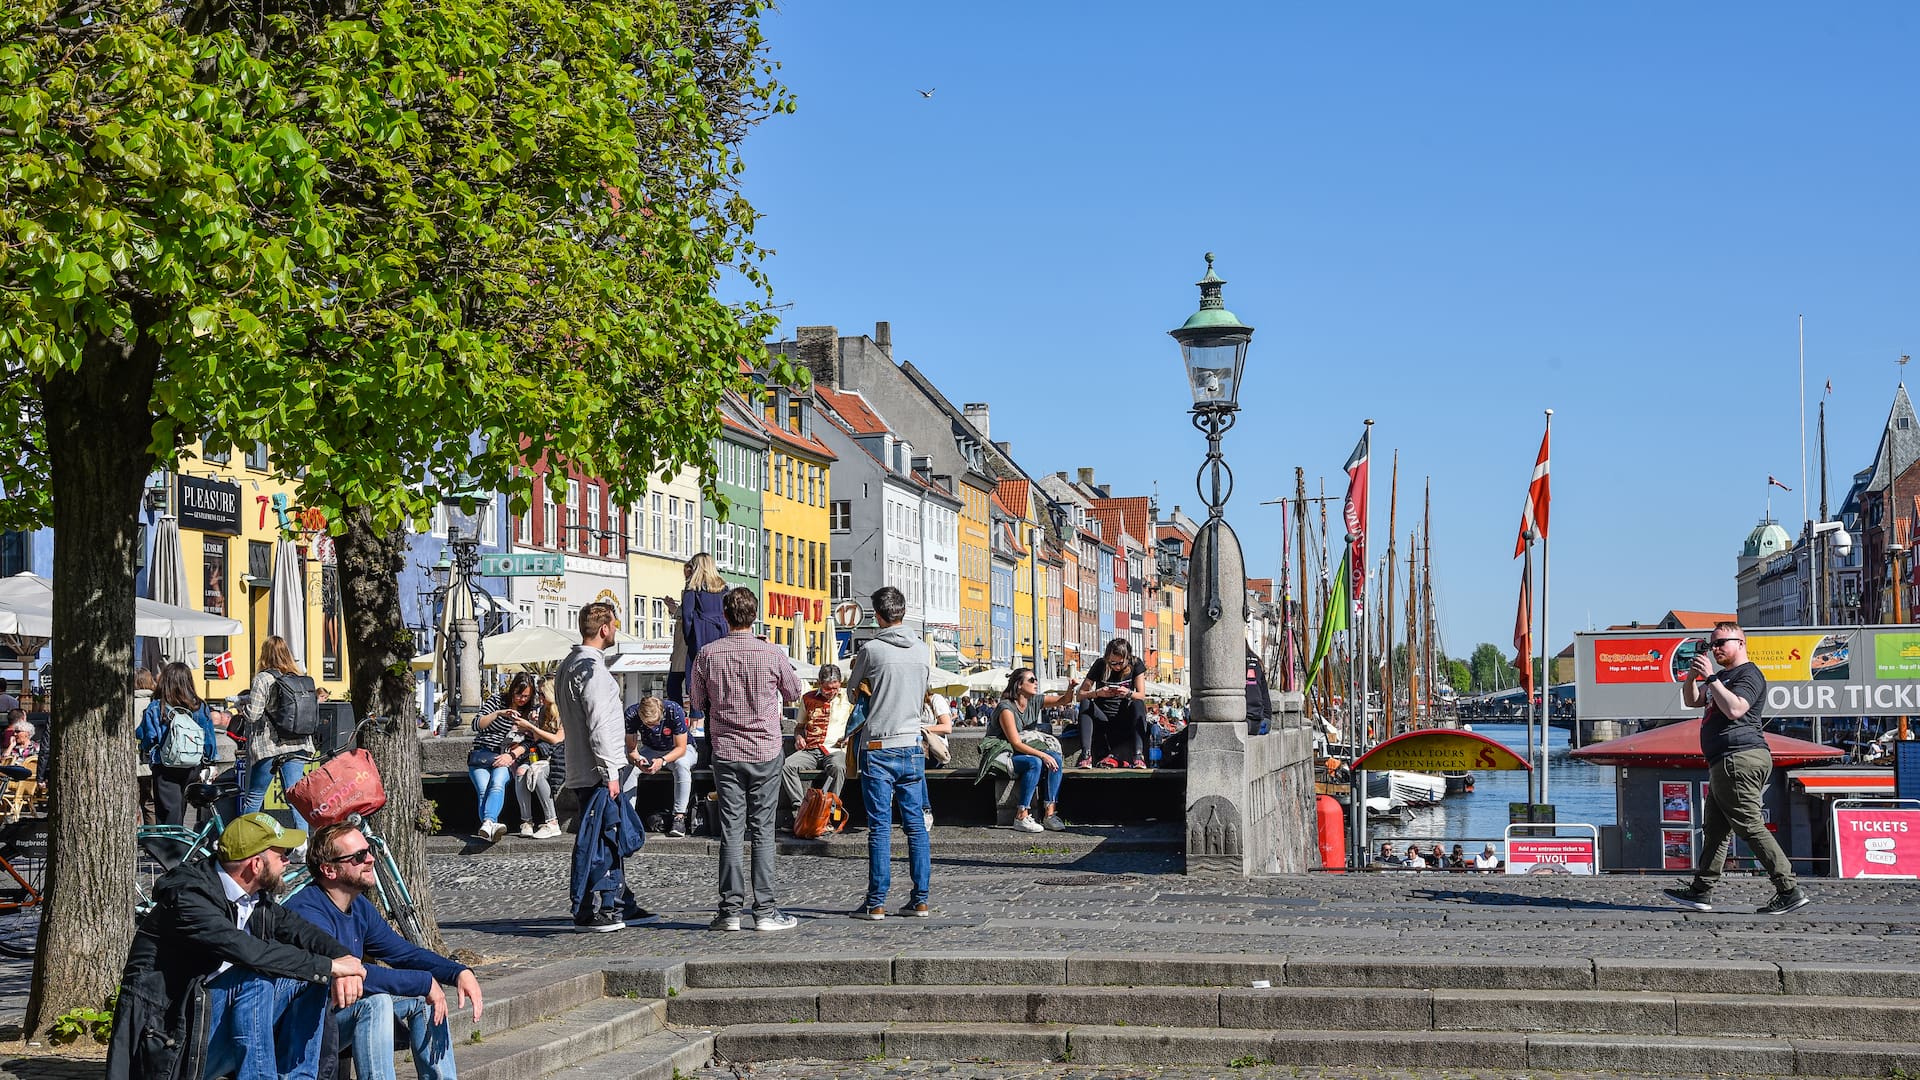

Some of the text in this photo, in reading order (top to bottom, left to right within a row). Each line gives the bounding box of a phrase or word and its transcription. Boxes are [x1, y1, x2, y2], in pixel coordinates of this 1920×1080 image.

[184, 486, 235, 513] PLEASURE
[485, 557, 557, 572] TOILET
[769, 592, 810, 622] NYHAVN
[836, 605, 858, 626] 17
[1768, 685, 1837, 709] OUR
[1387, 749, 1424, 757] CANAL
[1386, 760, 1466, 768] COPENHAGEN
[310, 771, 370, 819] momondo
[1850, 820, 1908, 832] TICKETS
[1536, 855, 1567, 863] TIVOLI
[1869, 853, 1893, 862] TICKET
